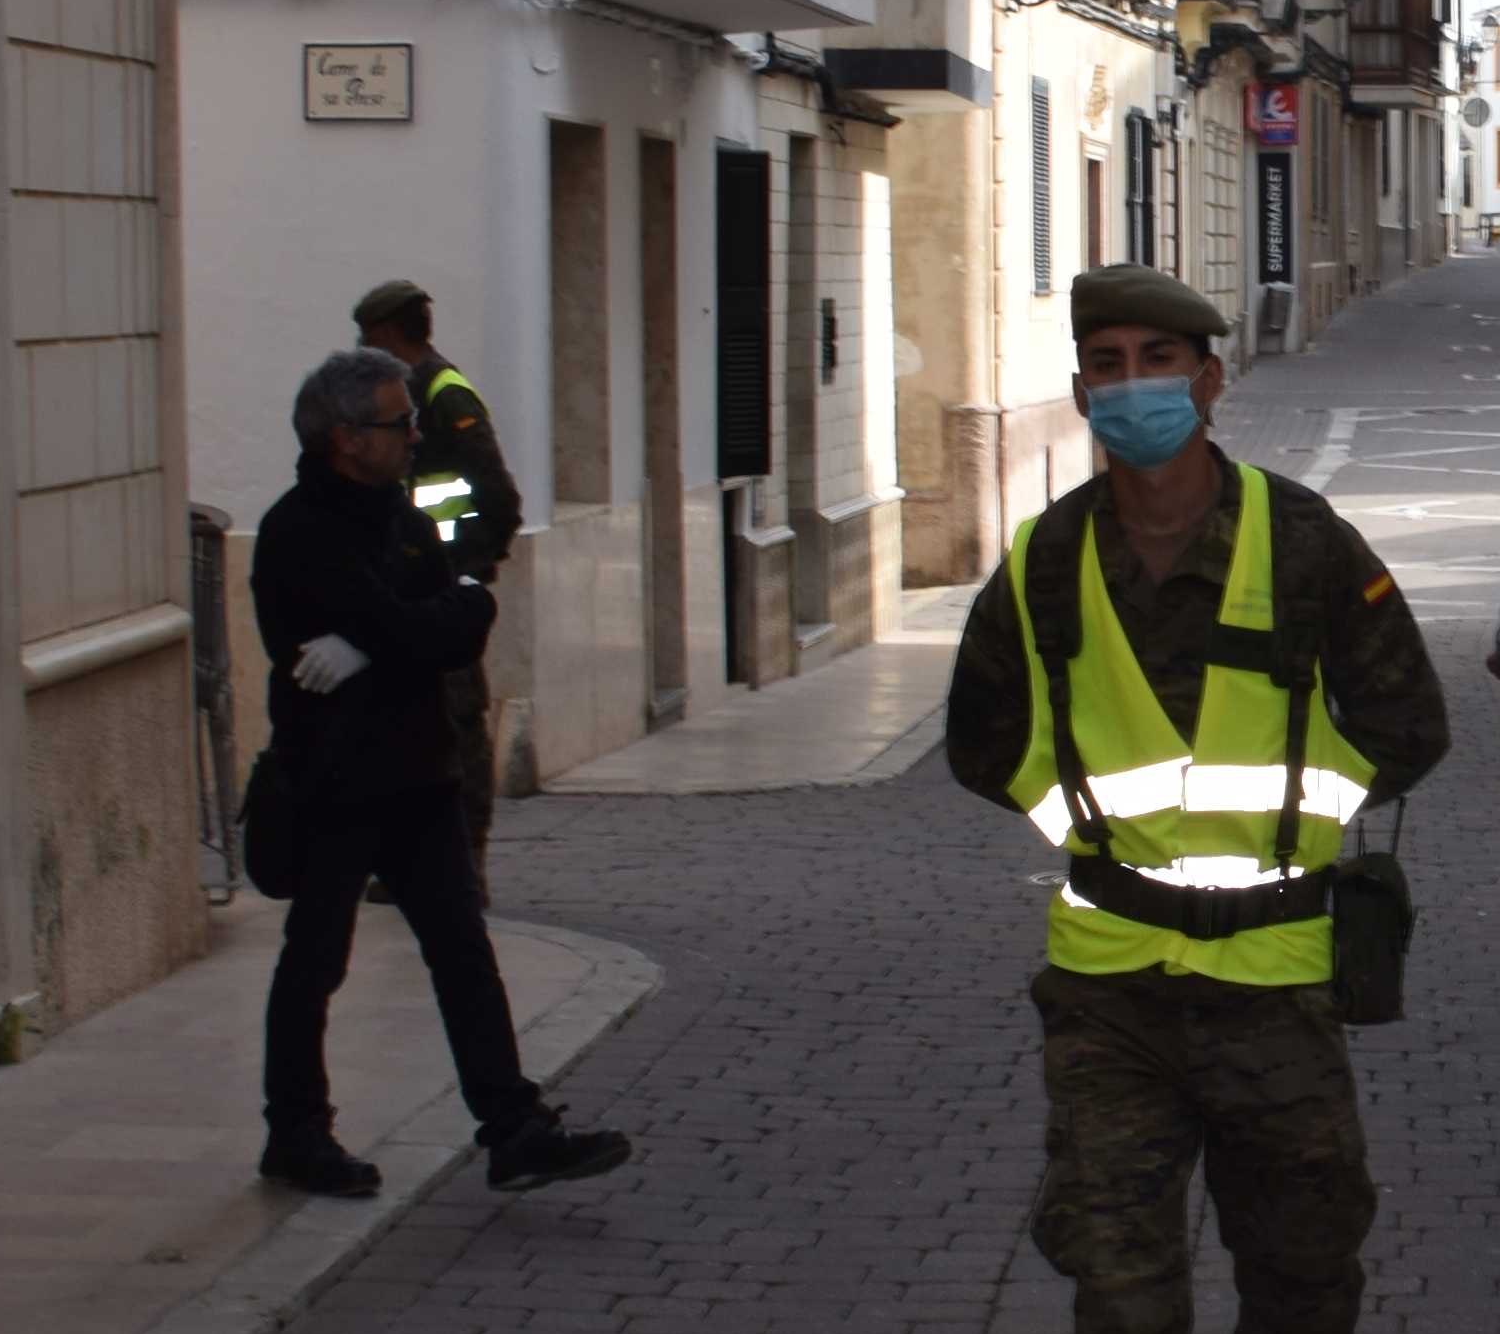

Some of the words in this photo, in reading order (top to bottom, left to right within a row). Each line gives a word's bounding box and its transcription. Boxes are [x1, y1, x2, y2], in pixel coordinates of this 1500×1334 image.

[316, 50, 358, 76] Carrer
[368, 51, 387, 76] de
[1266, 166, 1283, 272] SUPERMARKET
